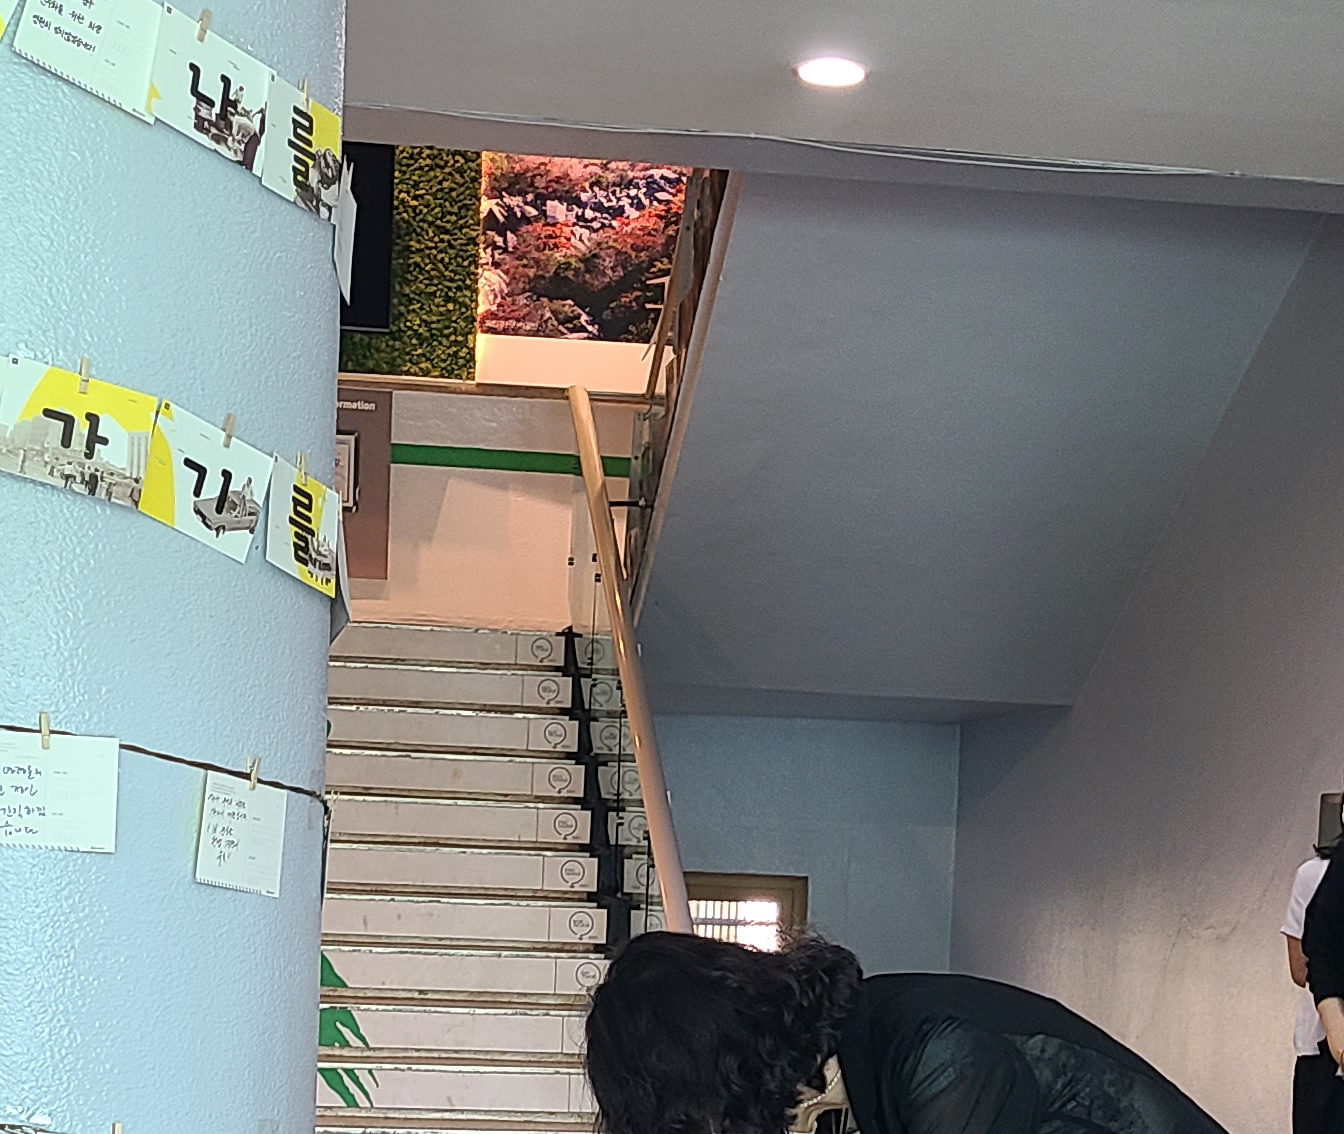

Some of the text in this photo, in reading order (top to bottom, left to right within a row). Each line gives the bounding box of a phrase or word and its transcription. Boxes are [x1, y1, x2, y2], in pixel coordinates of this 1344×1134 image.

[286, 104, 317, 193] 를
[41, 406, 111, 461] 가
[182, 456, 232, 516] 기
[287, 483, 318, 568] 를
